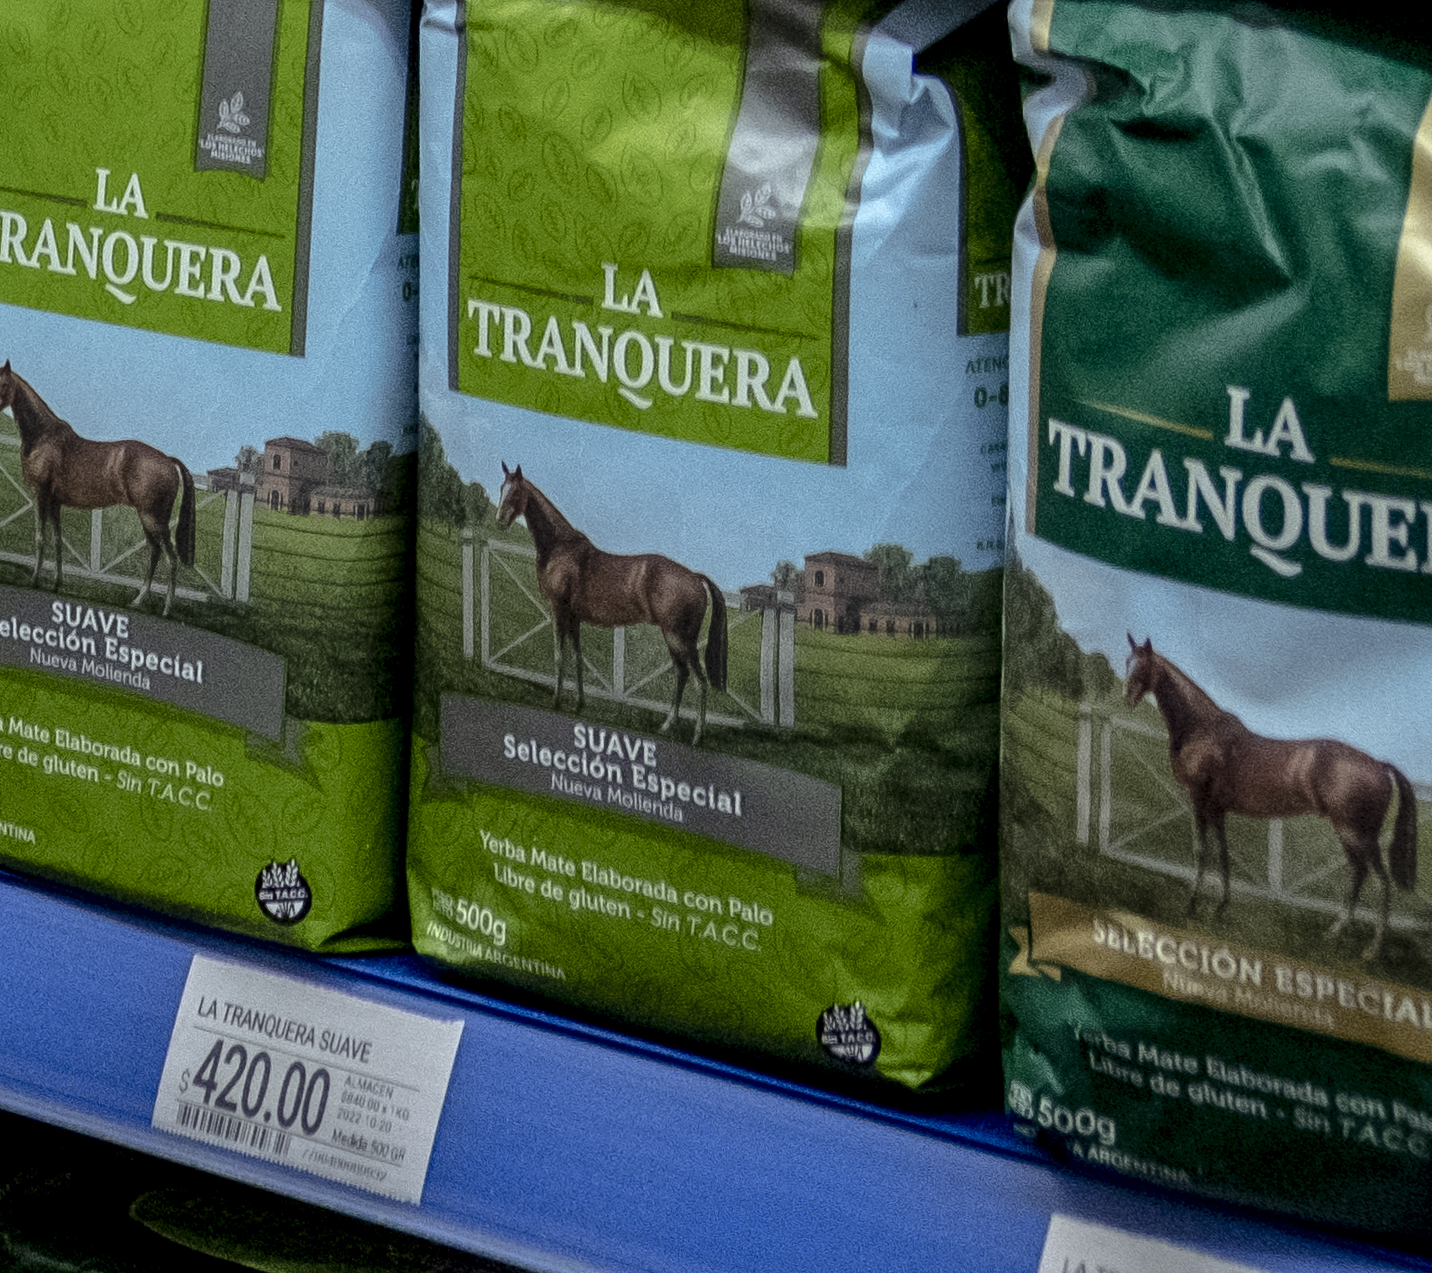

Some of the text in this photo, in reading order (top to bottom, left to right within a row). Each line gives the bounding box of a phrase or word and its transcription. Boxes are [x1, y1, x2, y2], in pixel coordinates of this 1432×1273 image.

[93, 167, 148, 217] LA
[601, 263, 664, 319] LA
[467, 300, 819, 420] TRANQUERA
[50, 602, 130, 639] SUAVE
[103, 639, 206, 683] Especial
[197, 996, 371, 1063] LA TRANQUERA SUAVE
